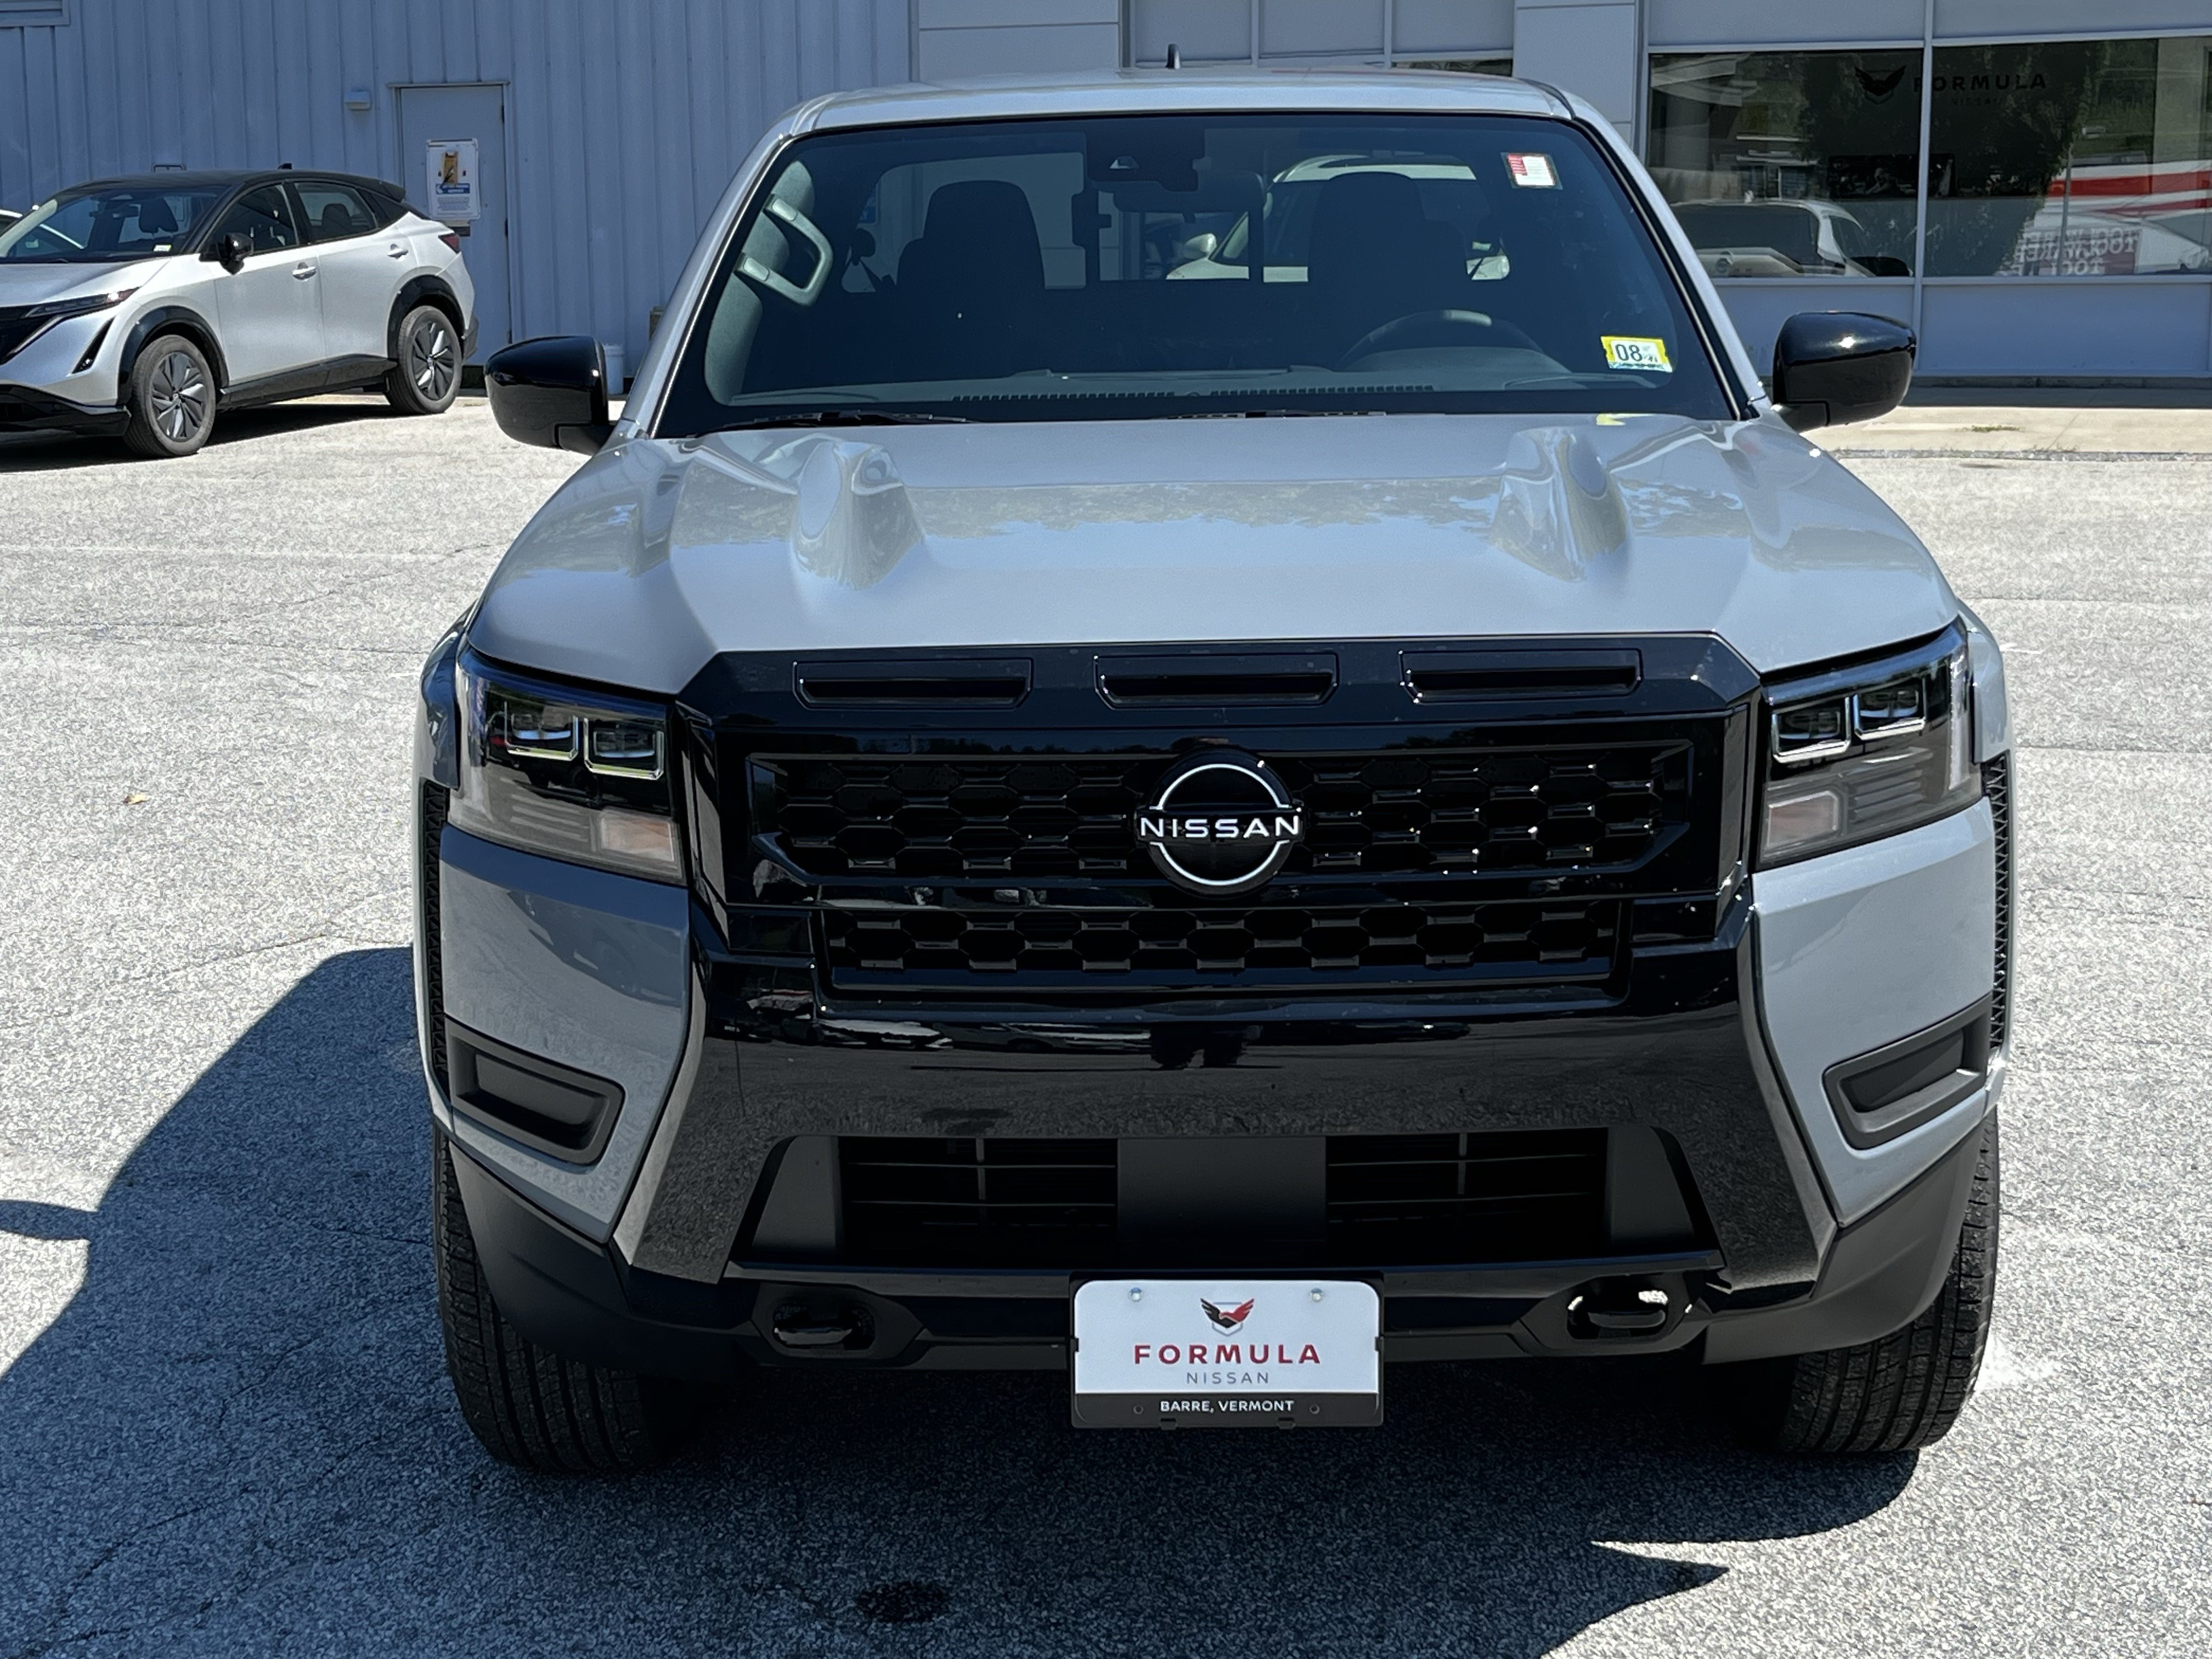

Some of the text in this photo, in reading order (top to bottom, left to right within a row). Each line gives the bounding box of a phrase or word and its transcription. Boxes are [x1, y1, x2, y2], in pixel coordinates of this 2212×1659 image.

[1615, 343, 1643, 362] 08
[1140, 815, 1300, 838] NISSAN
[1134, 1344, 1321, 1364] FORMULA
[1186, 1372, 1269, 1384] NISSAN
[1160, 1400, 1294, 1413] BARRE, VERMONT
